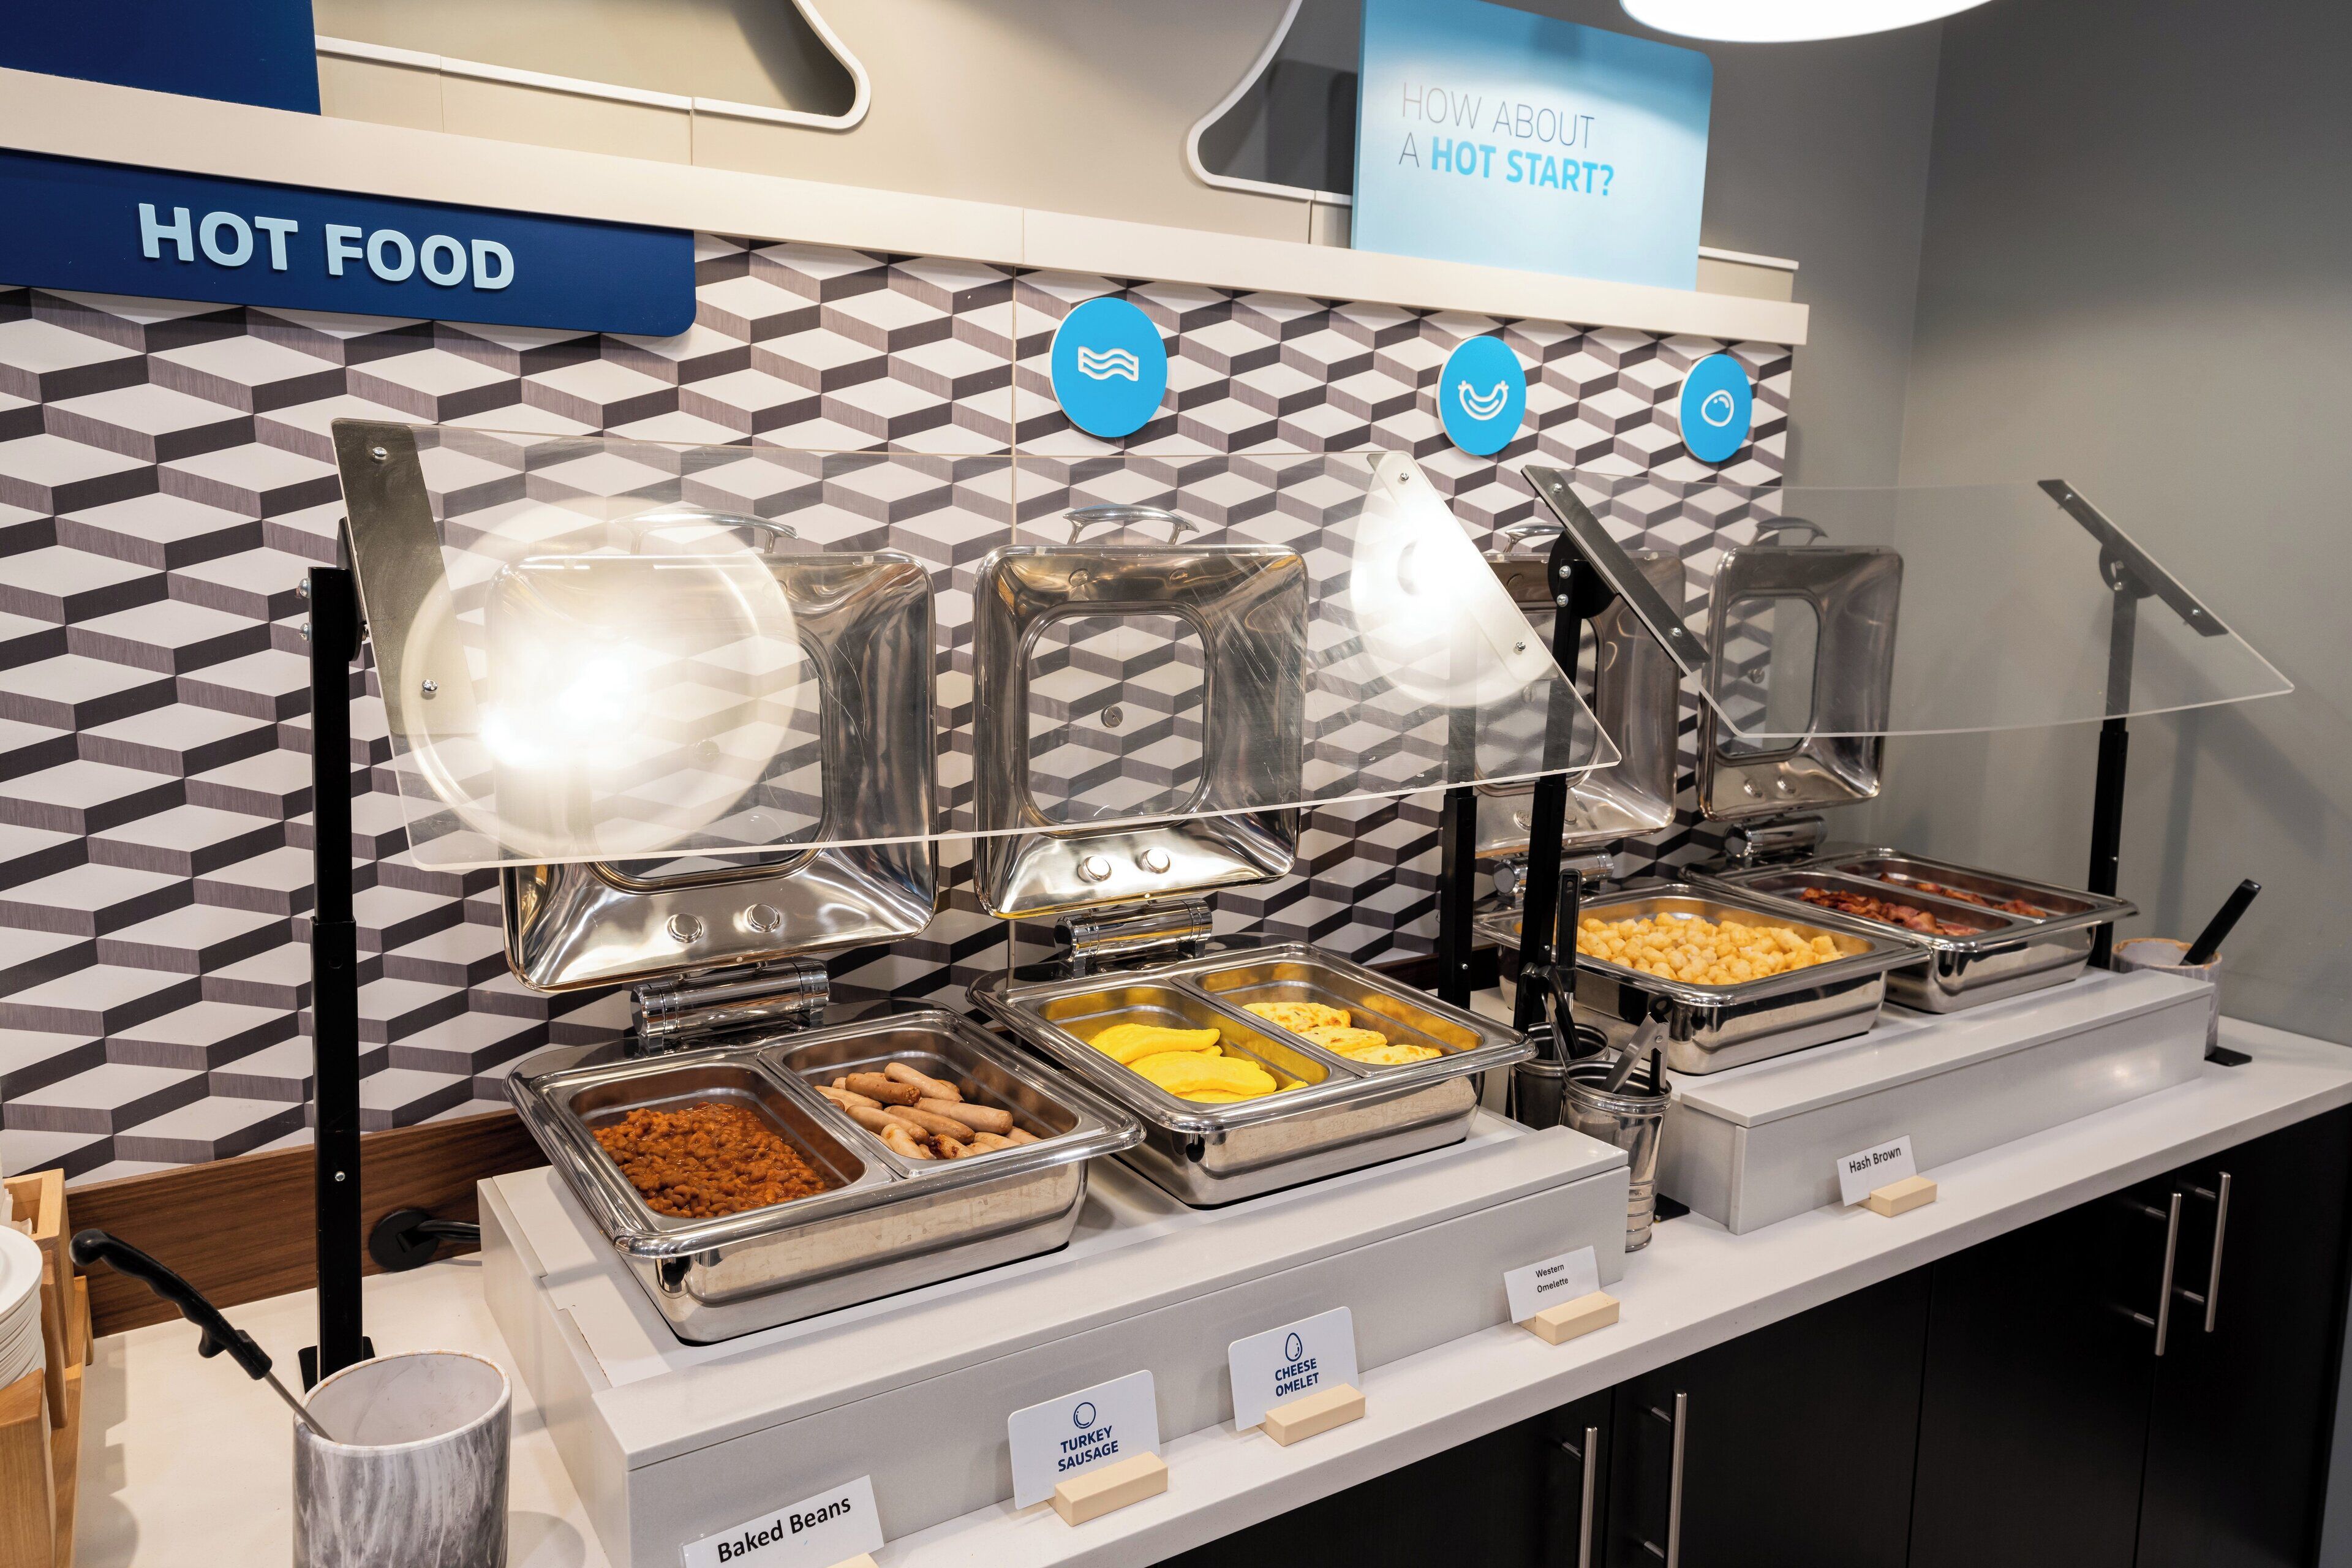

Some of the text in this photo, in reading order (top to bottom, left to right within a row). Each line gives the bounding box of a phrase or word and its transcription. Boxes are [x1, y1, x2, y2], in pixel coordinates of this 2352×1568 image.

[1402, 82, 1594, 148] HOW ABOUT
[1398, 132, 1615, 196] A HOT START?
[138, 203, 514, 290] HOT FOOD
[1849, 1147, 1902, 1174] Hash Brown
[1535, 1264, 1564, 1278] Western
[1537, 1278, 1569, 1293] Omelette
[1275, 1357, 1317, 1381] CHEESE
[1275, 1372, 1319, 1397] OMELET
[1060, 1425, 1112, 1453] TURKEY
[1058, 1440, 1119, 1472] SAUSAGE
[717, 1498, 851, 1563] Baked Beans
